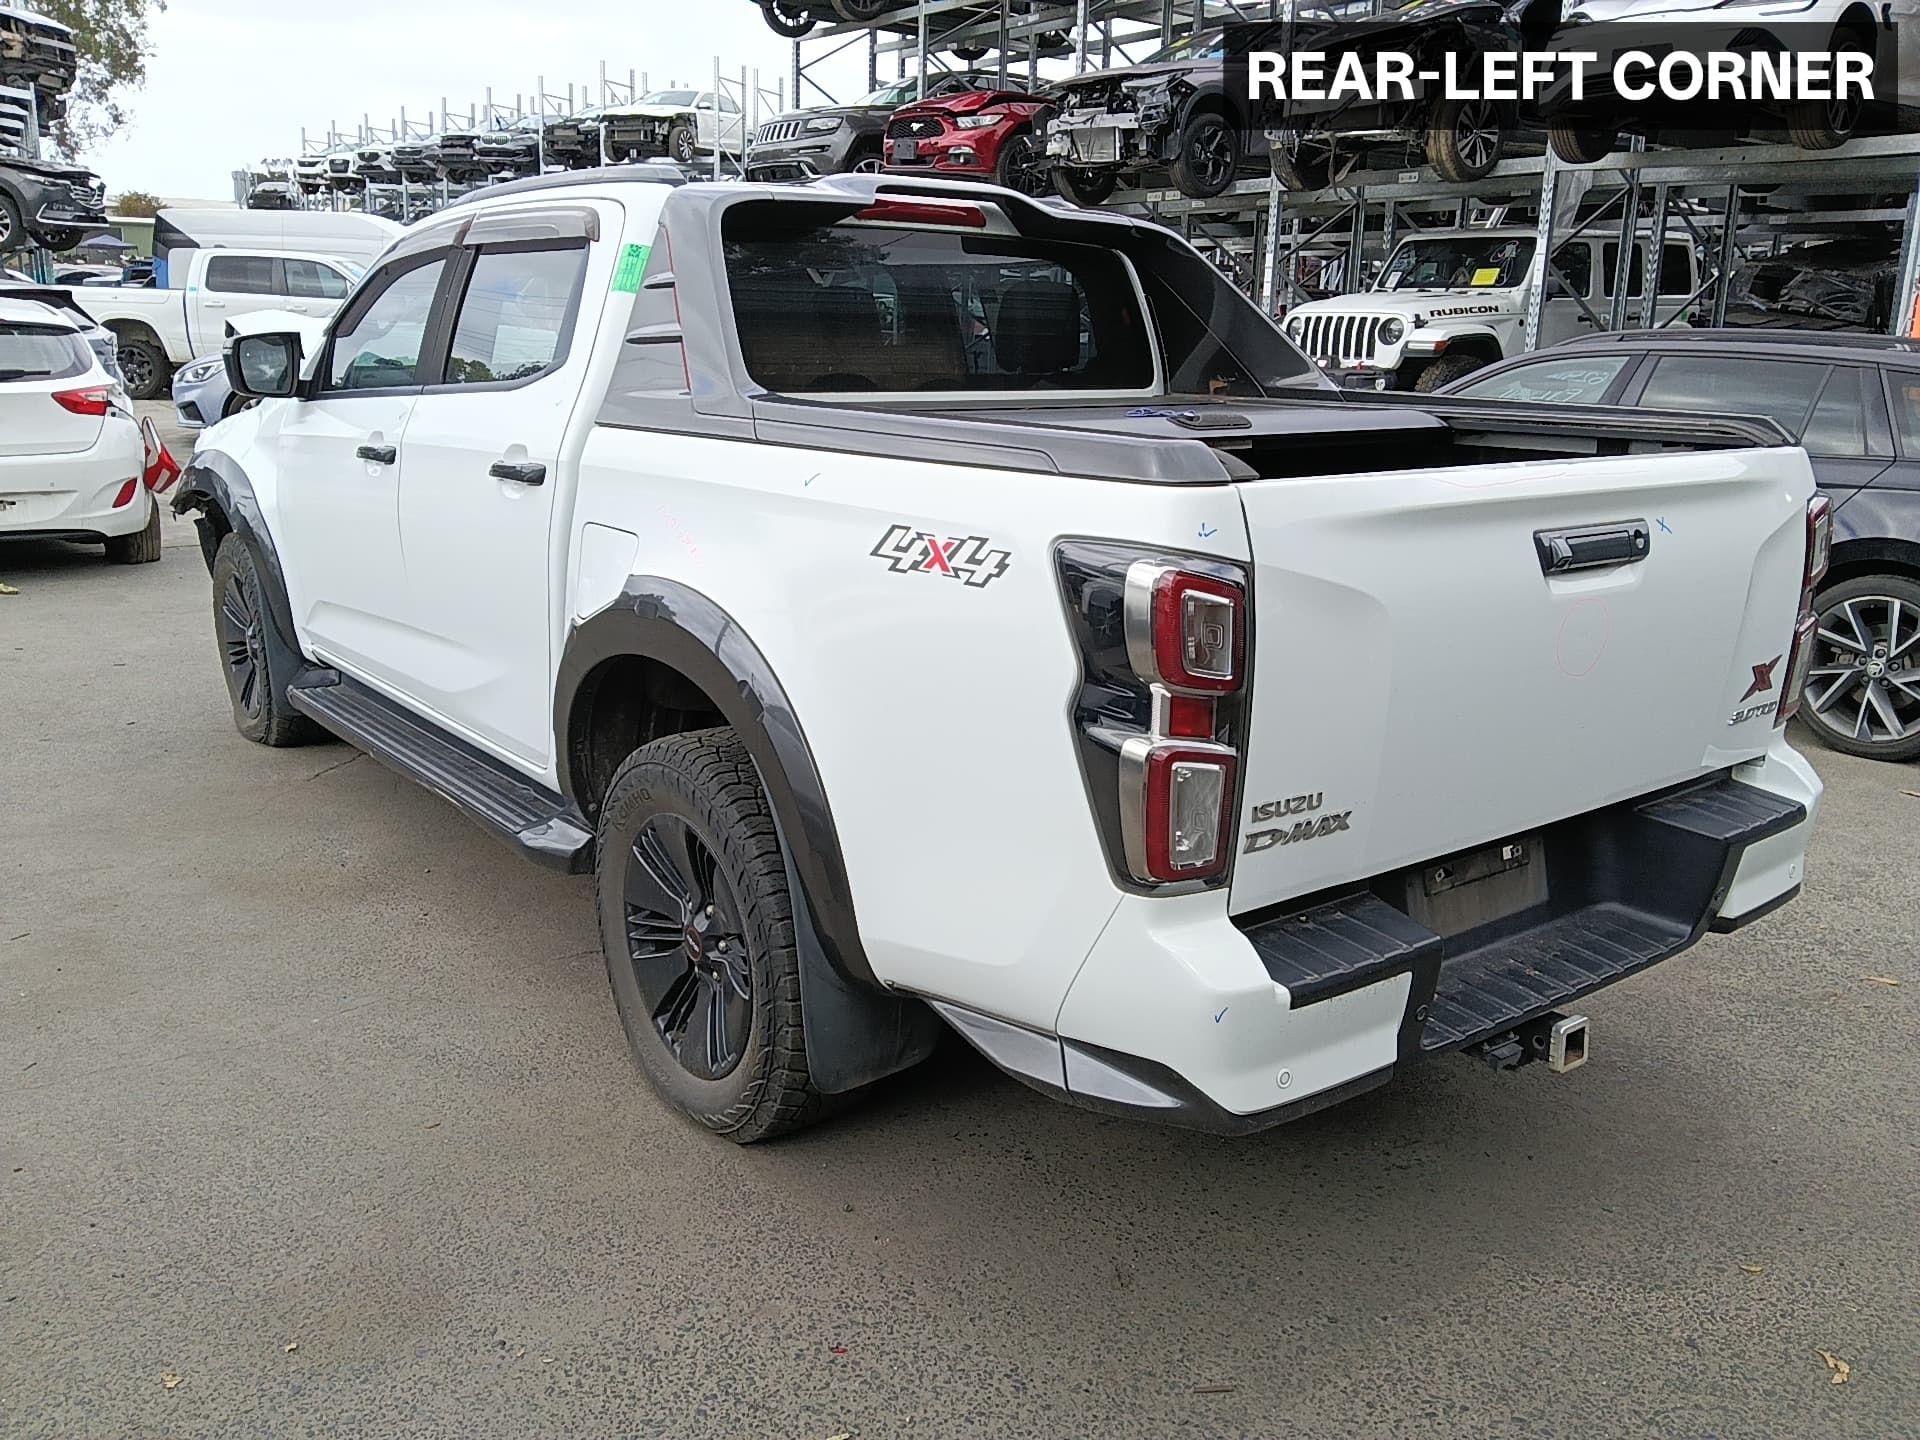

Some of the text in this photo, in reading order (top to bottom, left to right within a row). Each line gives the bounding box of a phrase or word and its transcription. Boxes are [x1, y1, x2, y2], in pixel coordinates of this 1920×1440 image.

[1429, 305, 1500, 318] RUBICON
[1251, 791, 1323, 824] ISUZU
[1243, 811, 1353, 855] D-MAX
